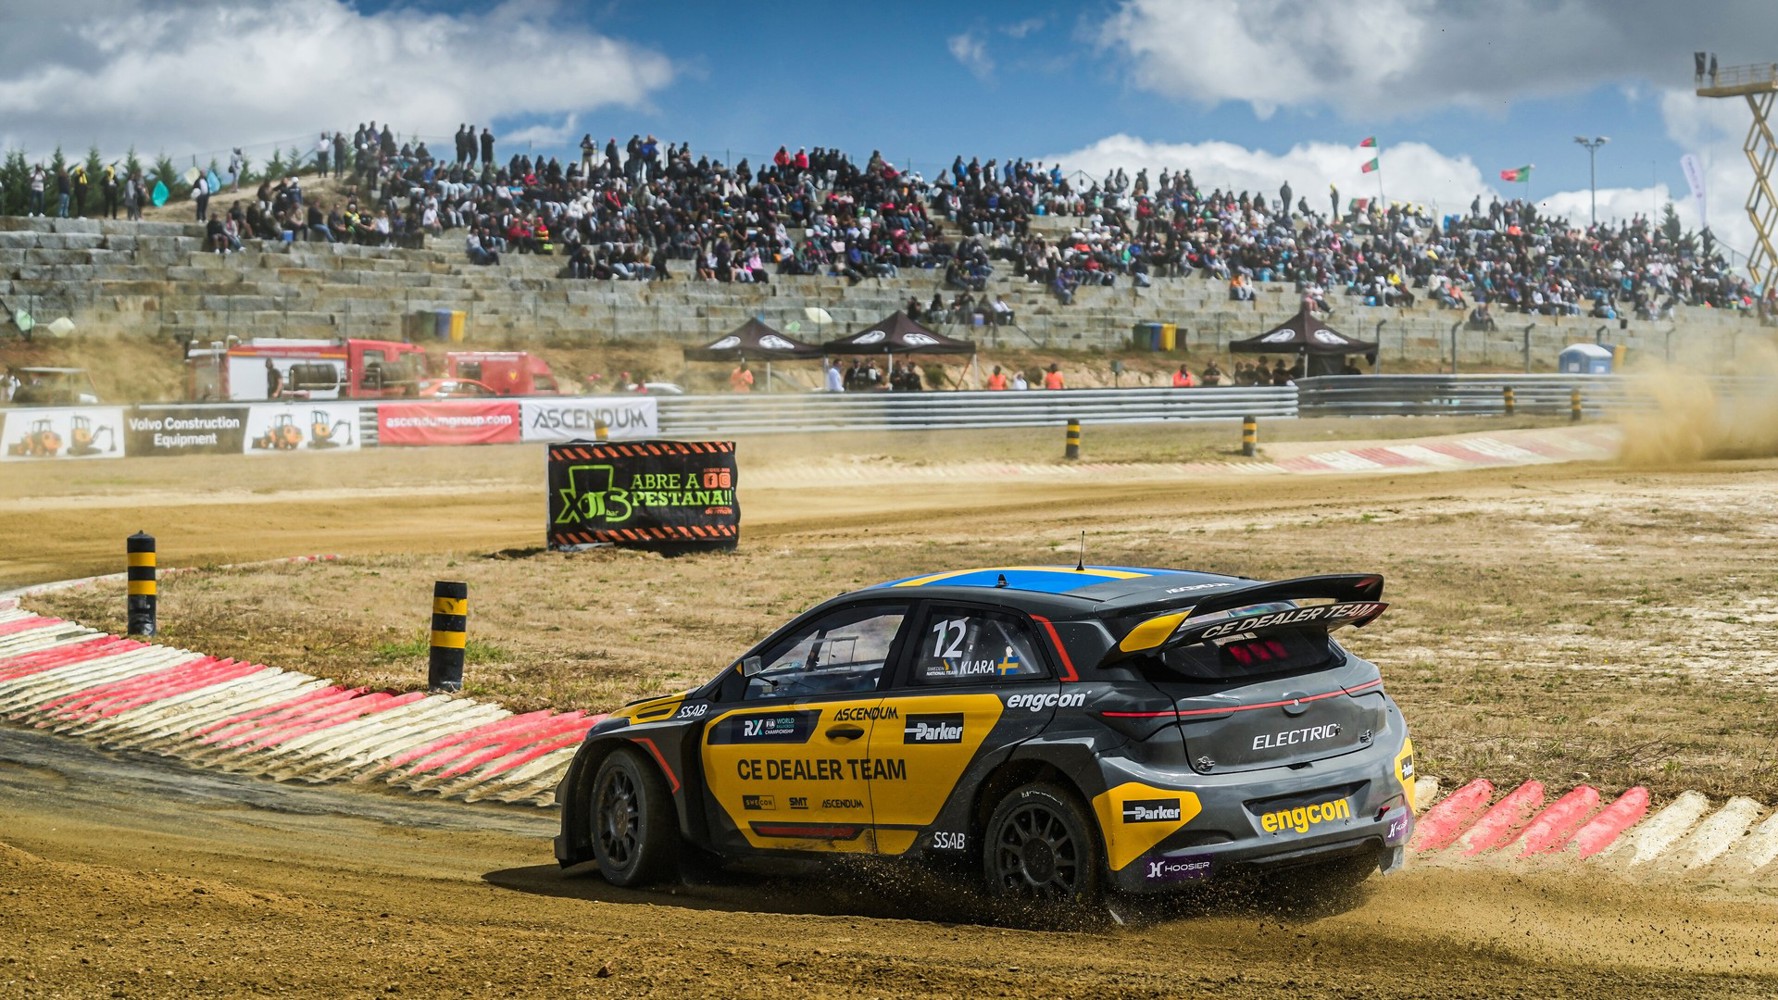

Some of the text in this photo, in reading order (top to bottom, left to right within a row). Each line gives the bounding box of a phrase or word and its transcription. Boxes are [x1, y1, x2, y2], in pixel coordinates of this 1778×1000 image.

[129, 416, 240, 431] Volvo Construction
[386, 414, 512, 430] ascendumgroup.com
[532, 408, 648, 429] ASCENDUM
[153, 432, 217, 448] Equipment
[630, 472, 700, 489] ABRE A
[632, 489, 733, 506] PESTANA!!
[1201, 603, 1379, 639] CE DEALER TEAM
[932, 619, 967, 658] 12
[959, 659, 994, 675] KLARA
[1007, 692, 1087, 712] engcon
[677, 703, 708, 719] SSAB
[833, 705, 899, 721] ASCENDUM
[743, 719, 764, 737] RX
[915, 720, 963, 741] Parker
[1252, 723, 1338, 751] ELECTRIC
[738, 758, 907, 780] CE DEALER TEAM
[789, 796, 808, 807] SMT
[821, 798, 864, 809] ASCENDUM
[1134, 805, 1180, 820] Parker
[1261, 798, 1351, 834] engcon
[933, 831, 965, 850] SSAB
[1164, 861, 1210, 872] HOOSIER
